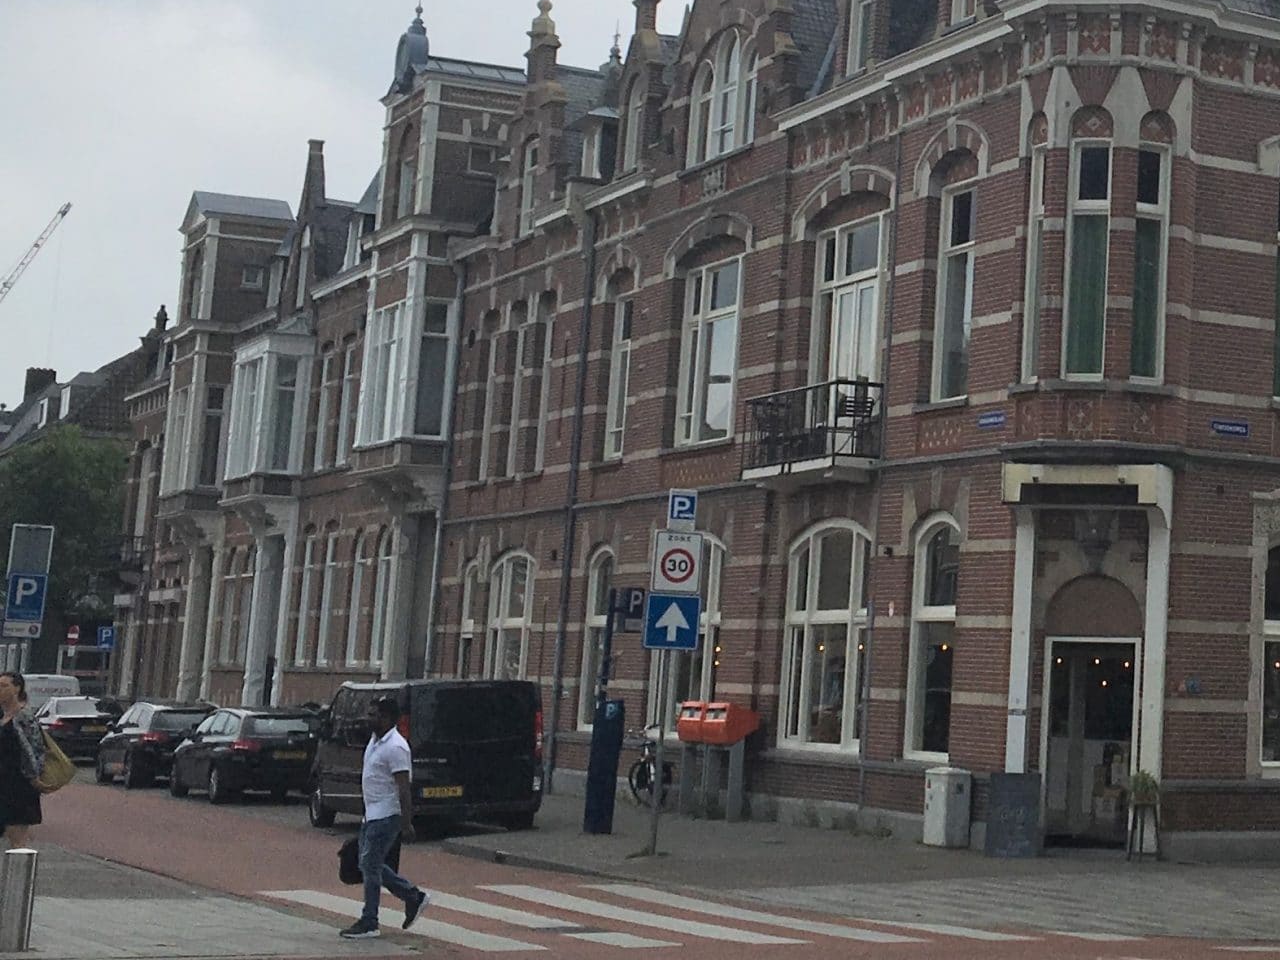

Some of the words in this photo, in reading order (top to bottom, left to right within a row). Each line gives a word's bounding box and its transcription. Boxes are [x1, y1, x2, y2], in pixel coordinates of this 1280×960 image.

[667, 535, 692, 543] ZONE
[667, 558, 688, 572] 30
[15, 577, 38, 606] P
[629, 590, 643, 613] P
[101, 629, 112, 642] P
